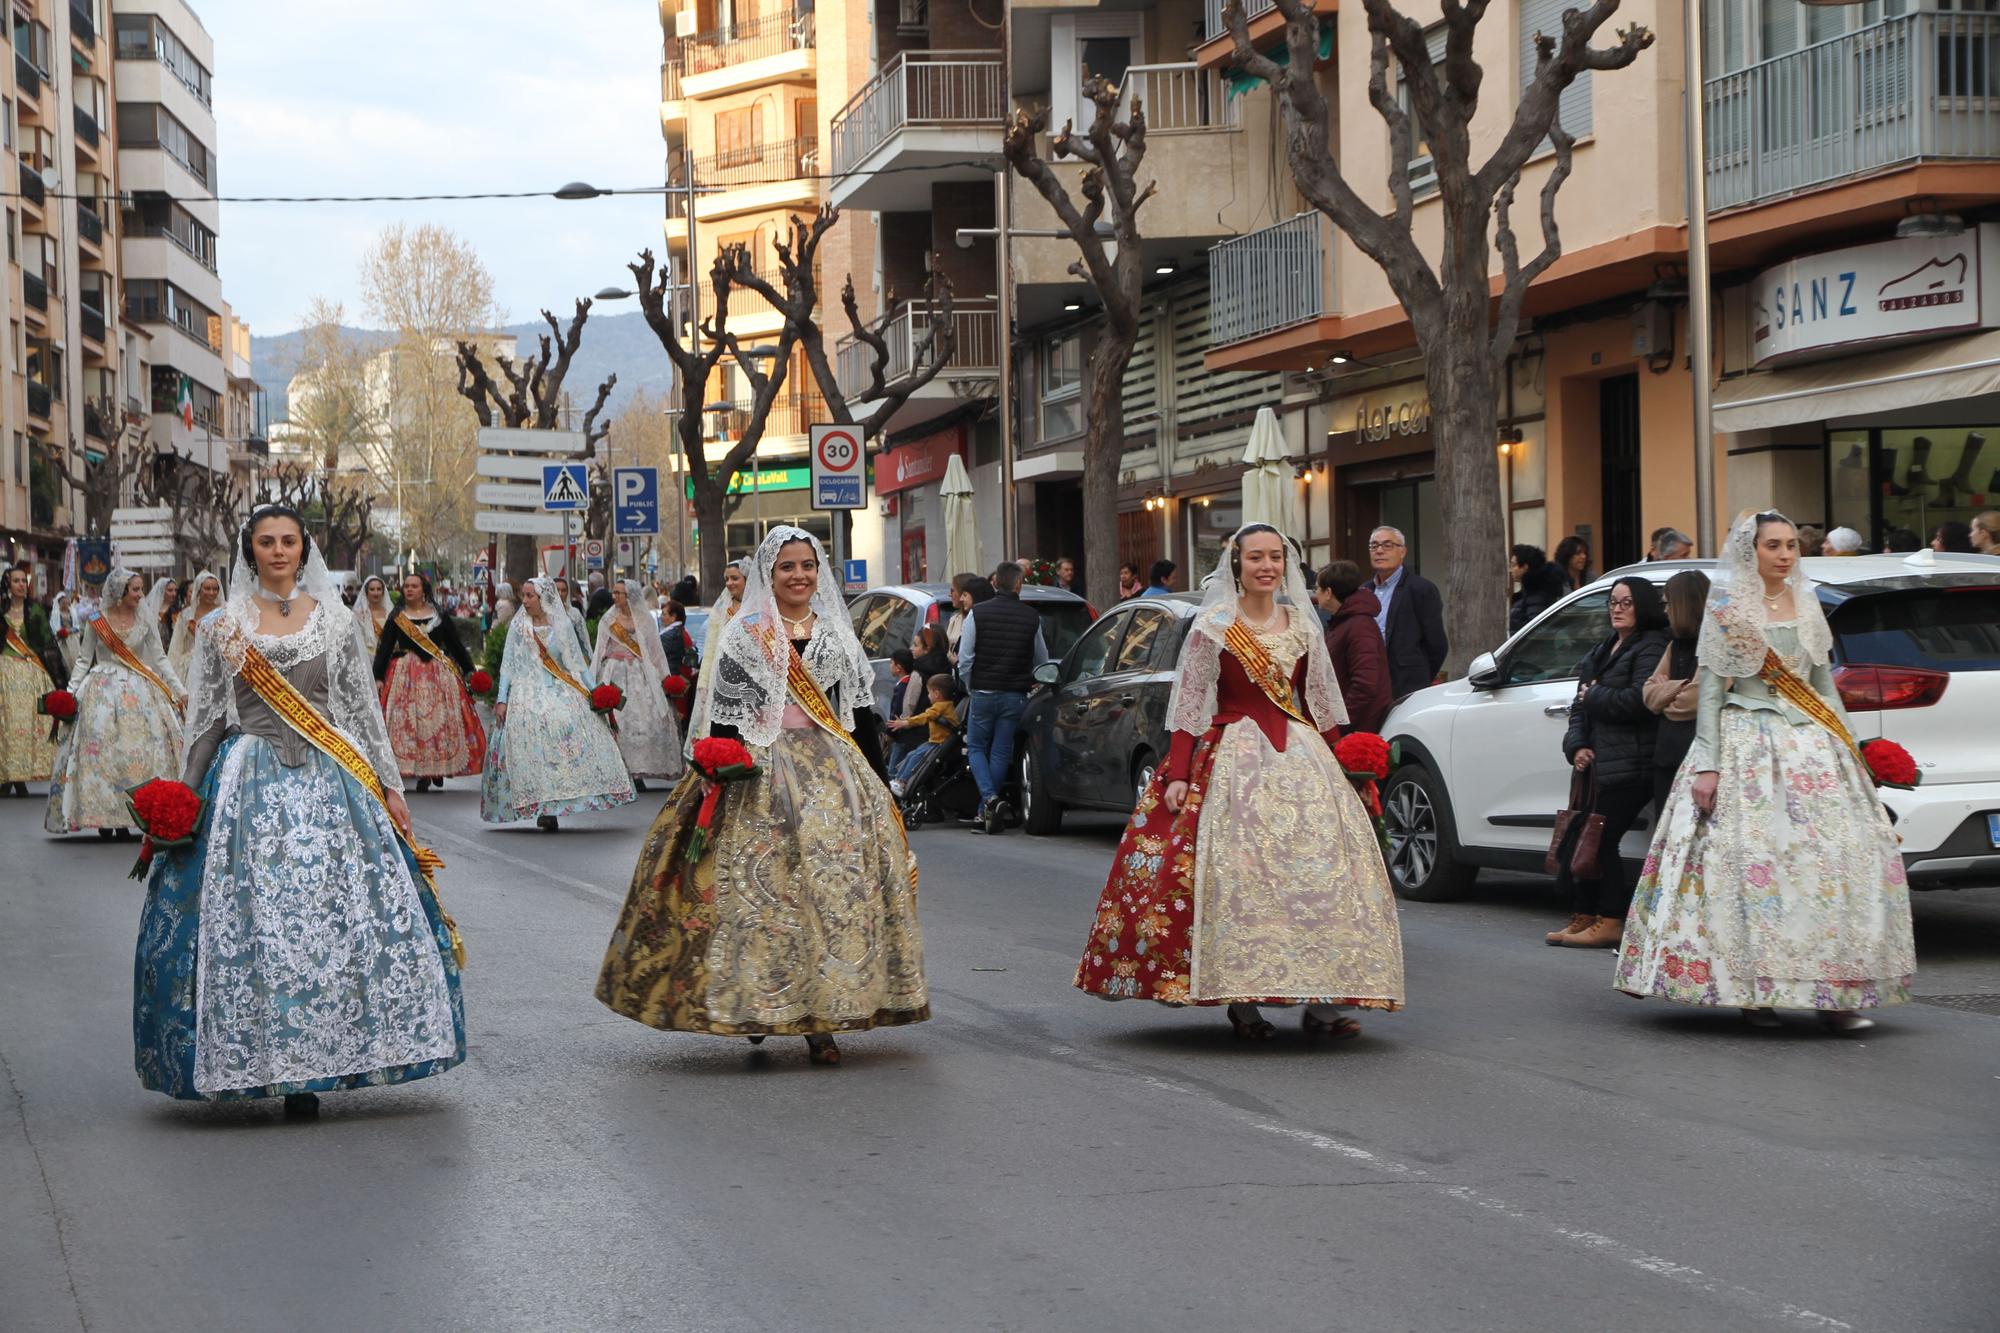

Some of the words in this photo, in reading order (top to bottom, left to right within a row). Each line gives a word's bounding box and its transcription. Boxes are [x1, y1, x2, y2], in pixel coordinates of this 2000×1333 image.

[1776, 271, 1857, 330] SANZ
[1880, 291, 1962, 312] CALZADOS
[827, 444, 850, 458] 30
[617, 471, 646, 508] P
[629, 500, 655, 508] PUBLIC
[850, 563, 861, 580] L
